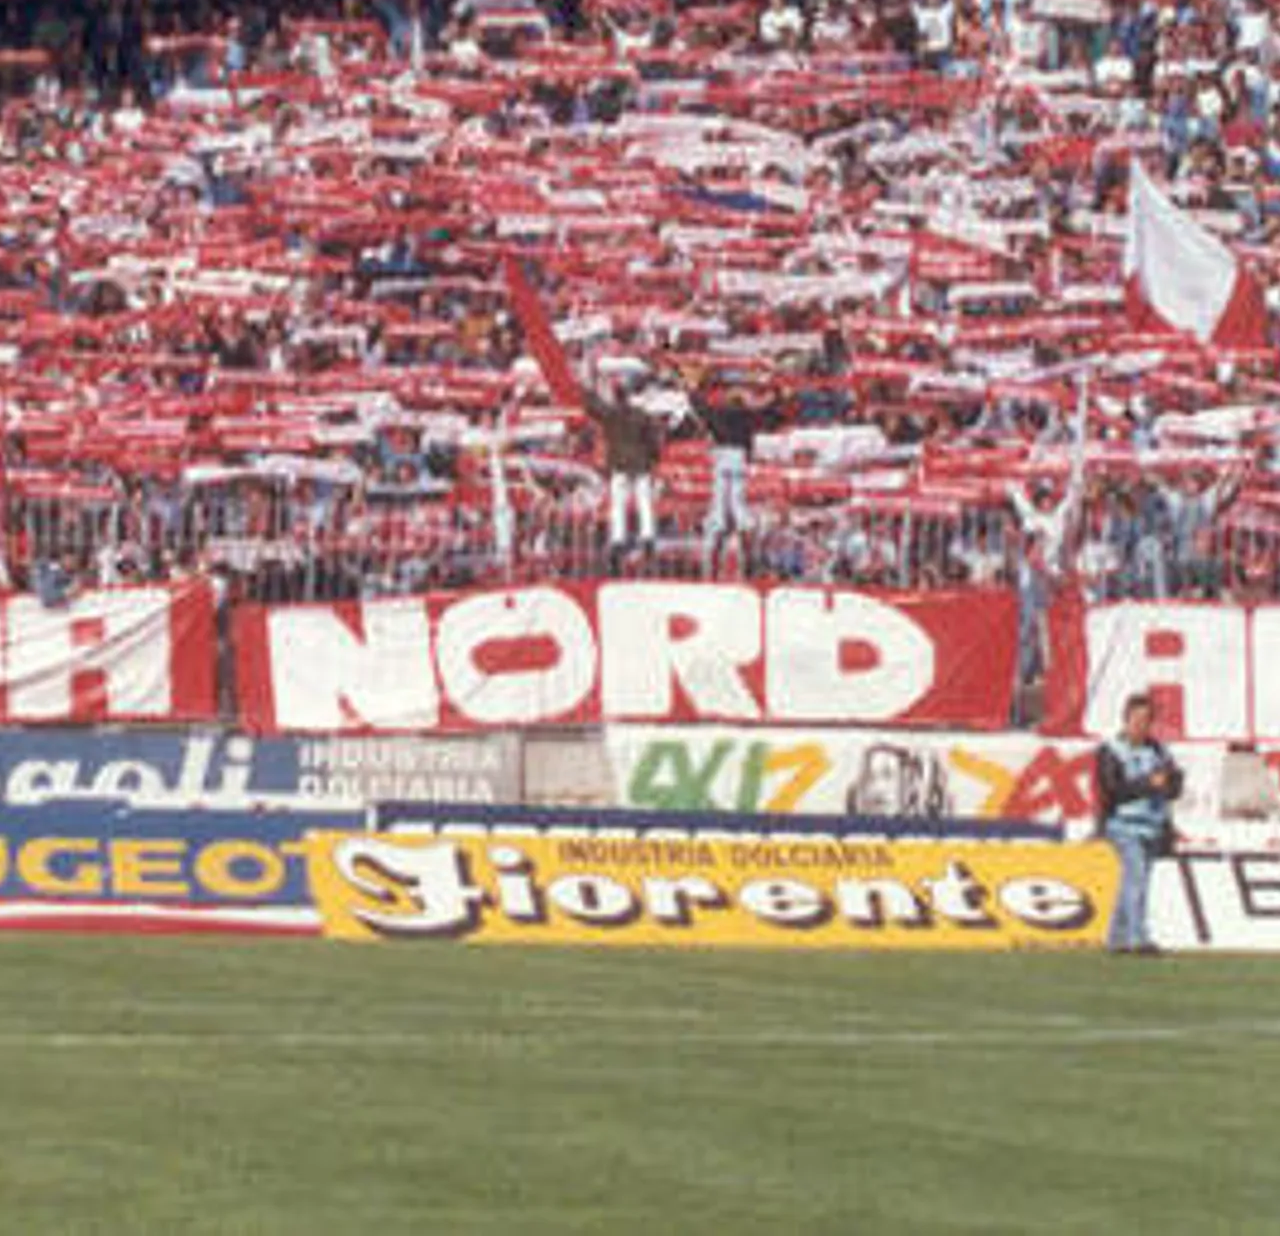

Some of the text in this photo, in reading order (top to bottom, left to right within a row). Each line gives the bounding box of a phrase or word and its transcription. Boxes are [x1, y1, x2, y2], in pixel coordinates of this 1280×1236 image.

[265, 582, 936, 729] NORD
[334, 838, 1096, 938] Fiorente
[556, 839, 895, 869] INDUSTRIA DOLCIARIA
